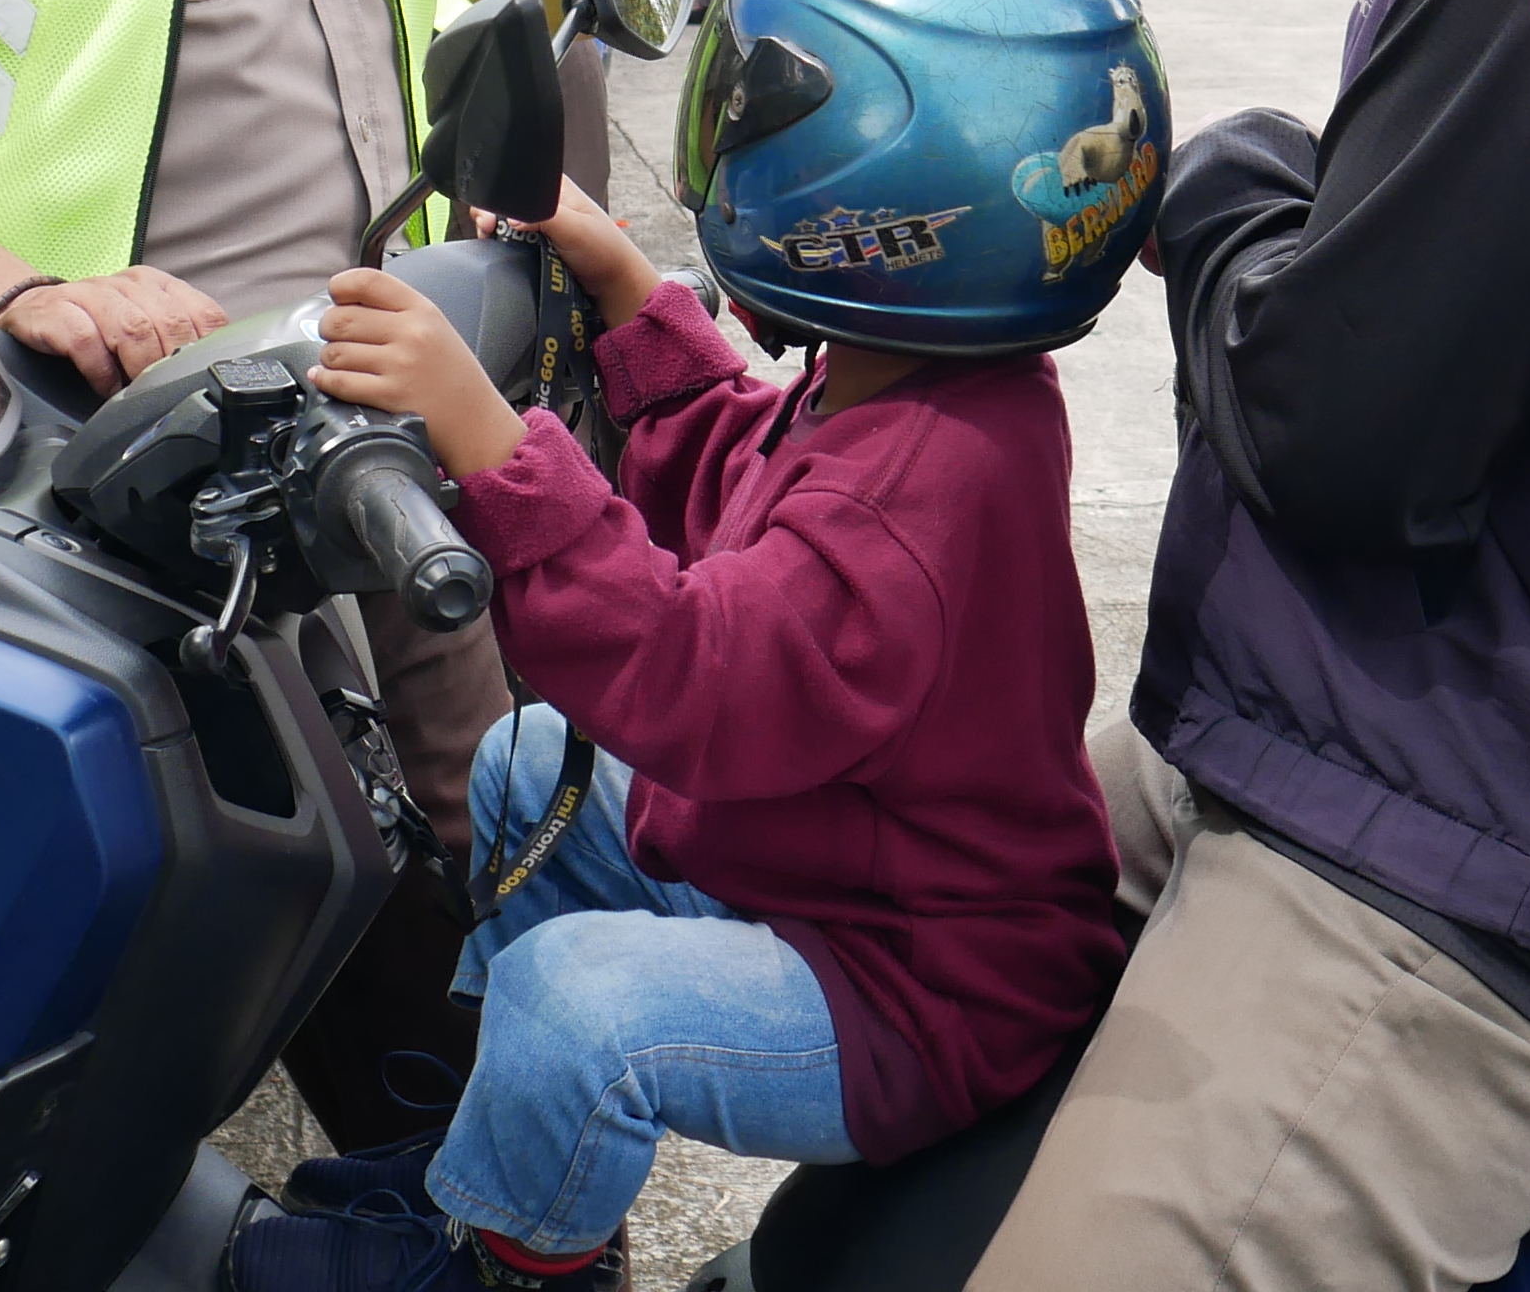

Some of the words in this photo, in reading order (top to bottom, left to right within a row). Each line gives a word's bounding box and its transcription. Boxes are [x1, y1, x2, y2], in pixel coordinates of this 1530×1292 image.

[1045, 141, 1159, 266] BERNARD
[780, 215, 941, 271] CTR
[886, 249, 945, 270] HELMETS
